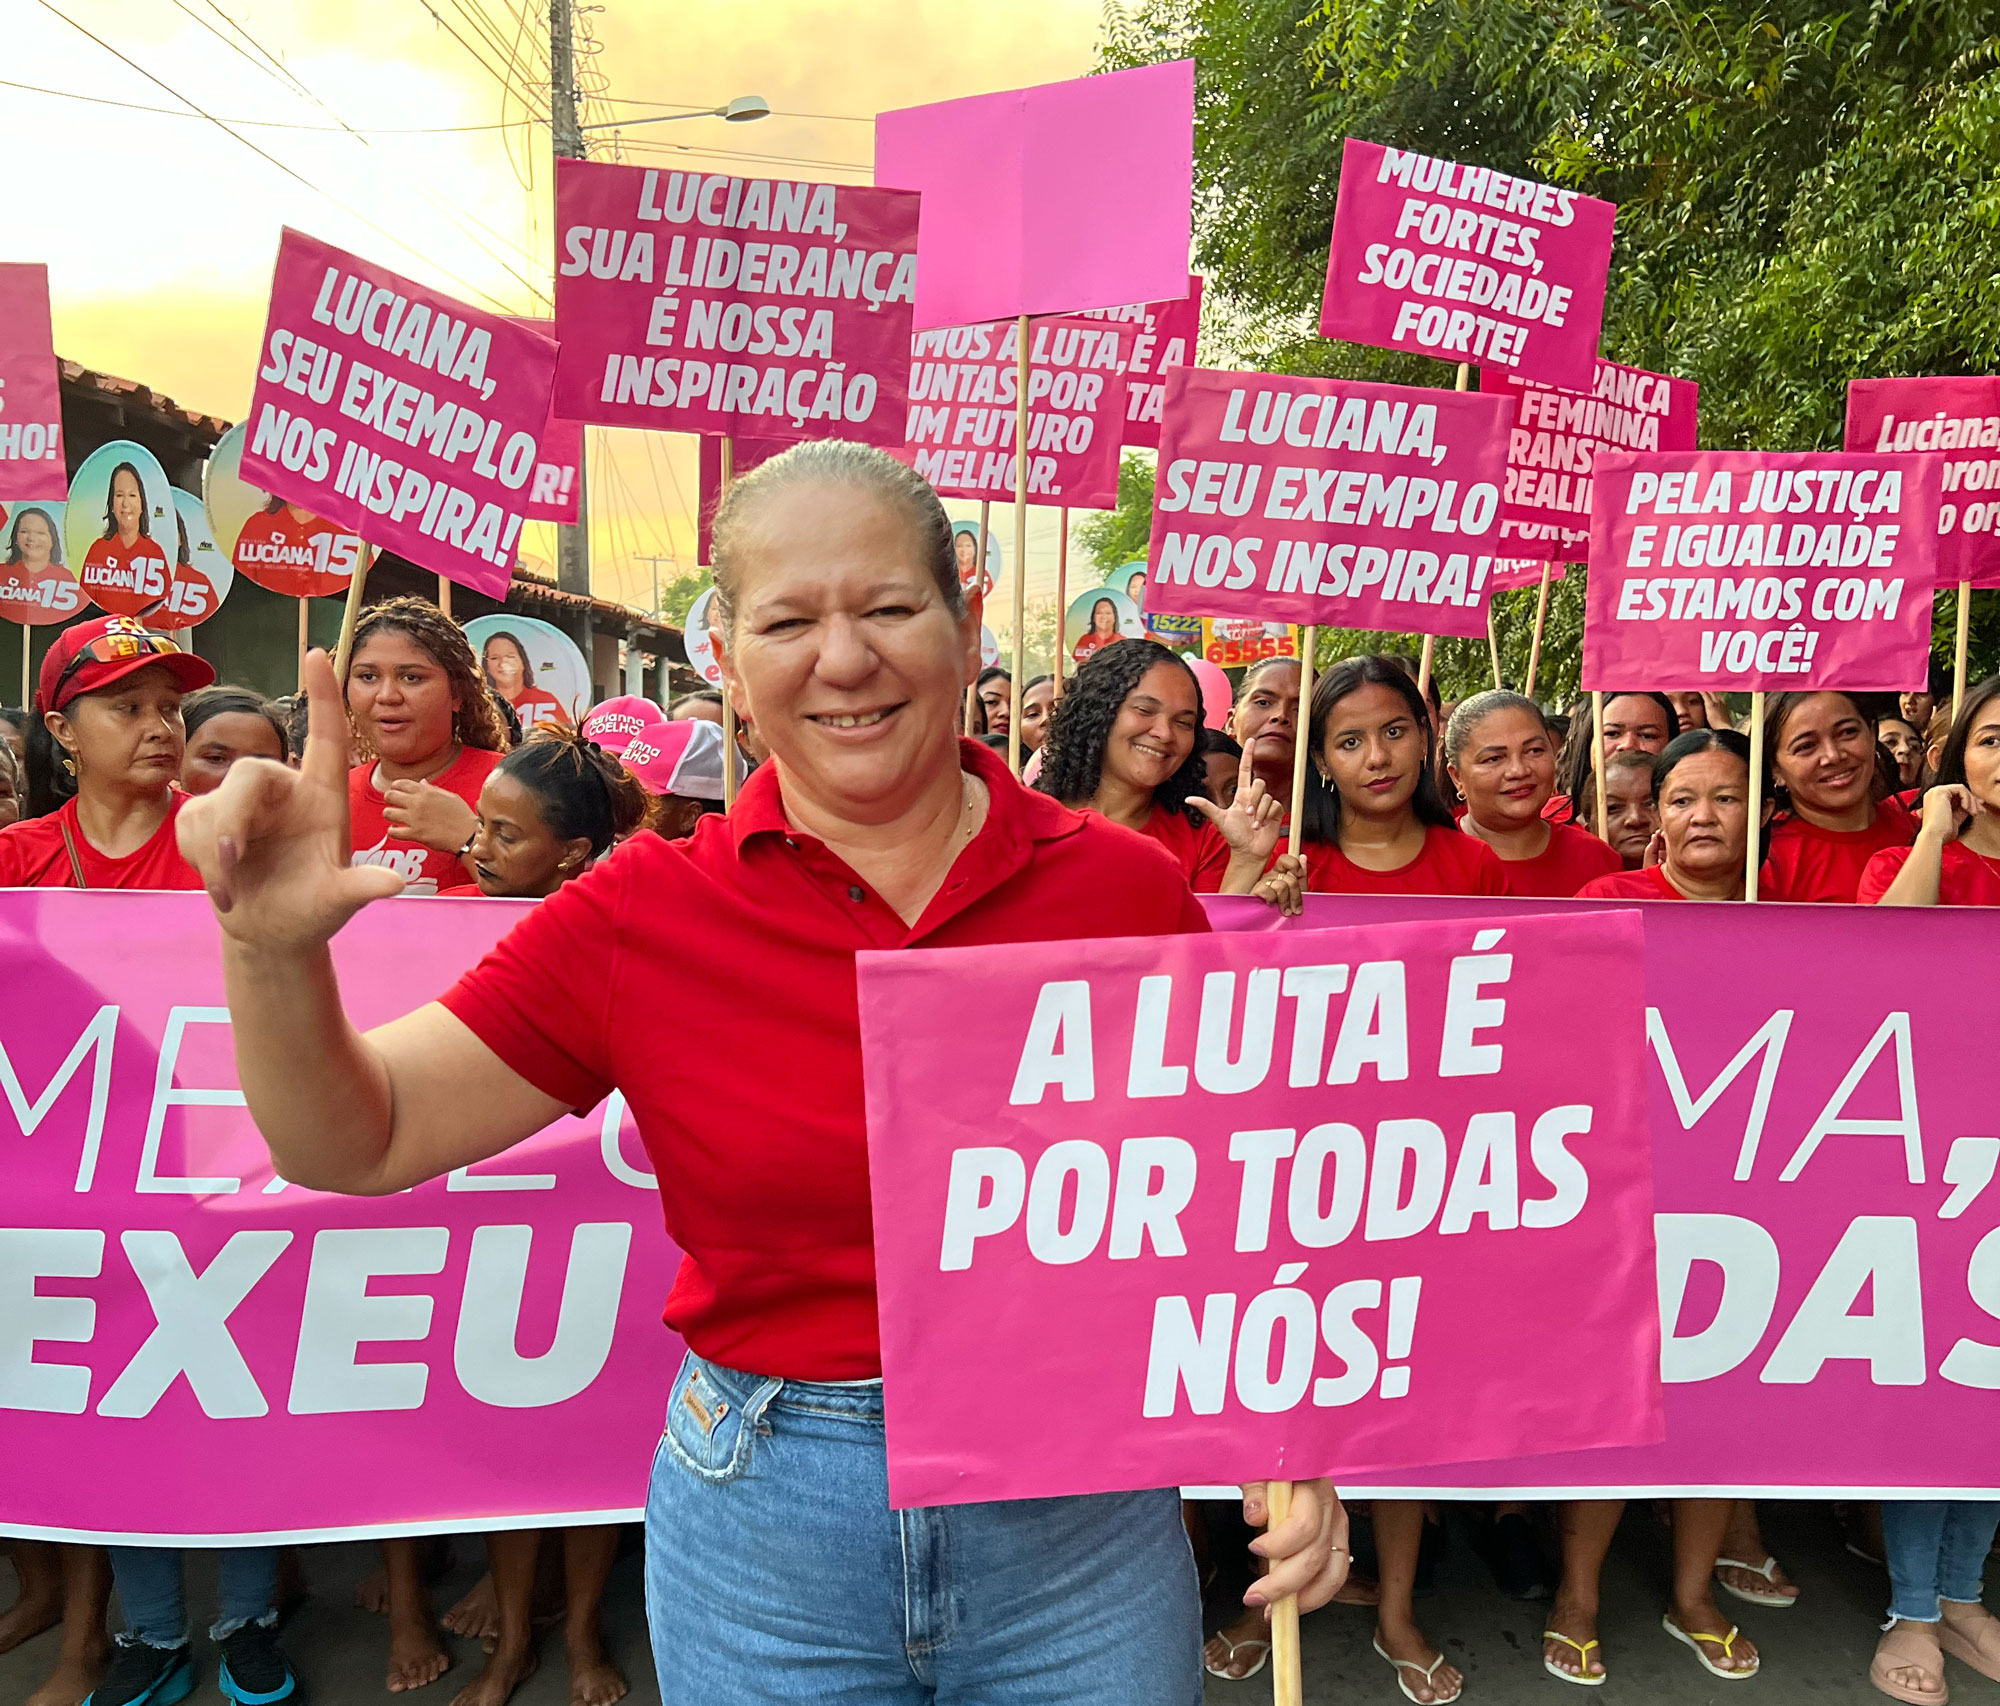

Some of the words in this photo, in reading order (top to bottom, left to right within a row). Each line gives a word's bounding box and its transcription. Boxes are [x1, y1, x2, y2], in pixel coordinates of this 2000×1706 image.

[637, 169, 848, 244] LUCIANA,
[1377, 147, 1579, 228] MULHERES
[561, 225, 652, 284] SUA
[665, 236, 917, 312] LIDERANÇA
[1395, 201, 1544, 274] FORTES,
[1358, 244, 1573, 328] SOCIEDADE
[311, 266, 497, 401] LUCIANA,
[645, 286, 678, 347] É
[684, 299, 834, 359] NOSSA
[911, 323, 995, 360] MOS
[1030, 326, 1127, 377] LUTA,
[1392, 307, 1529, 369] FORTE!
[1156, 337, 1186, 375] A
[260, 329, 344, 405] SEU
[339, 361, 537, 491] EXEMPLO
[601, 353, 878, 428] INSPIRAÇÃO
[1027, 369, 1104, 412] POR
[1126, 382, 1166, 424] TA
[1519, 389, 1659, 453] FEMININA
[952, 407, 1094, 455] FUTURO
[1219, 388, 1448, 467] LUCIANA,
[251, 403, 337, 486] NOS
[334, 437, 525, 568] INSPIRA!
[913, 448, 1062, 496] MELHOR.
[1159, 460, 1259, 518] SEU
[1263, 466, 1499, 537] EXEMPLO
[1625, 471, 1732, 516] PELA
[1740, 469, 1902, 523] JUSTIÇA
[130, 556, 165, 596] 15
[239, 543, 314, 566] LUCIANA
[308, 532, 360, 576] 15
[1155, 532, 1261, 590] NOS
[1265, 540, 1492, 608] INSPIRA!
[1626, 524, 1658, 569] E
[1661, 523, 1898, 569] IGUALDADE
[0, 586, 41, 603] CIANA
[38, 579, 80, 611] 15
[168, 581, 209, 615] 15
[1616, 577, 1806, 622] ESTAMOS
[1810, 577, 1904, 622] COM
[1206, 636, 1294, 664] 65555
[1699, 623, 1818, 675] VOCÊ!
[1009, 980, 1095, 1107] A
[1127, 961, 1409, 1098] LUTA
[1438, 929, 1512, 1077] É
[939, 1137, 1198, 1272] POR
[1228, 1104, 1594, 1253] TODAS
[1142, 1262, 1422, 1419] NÓS!
